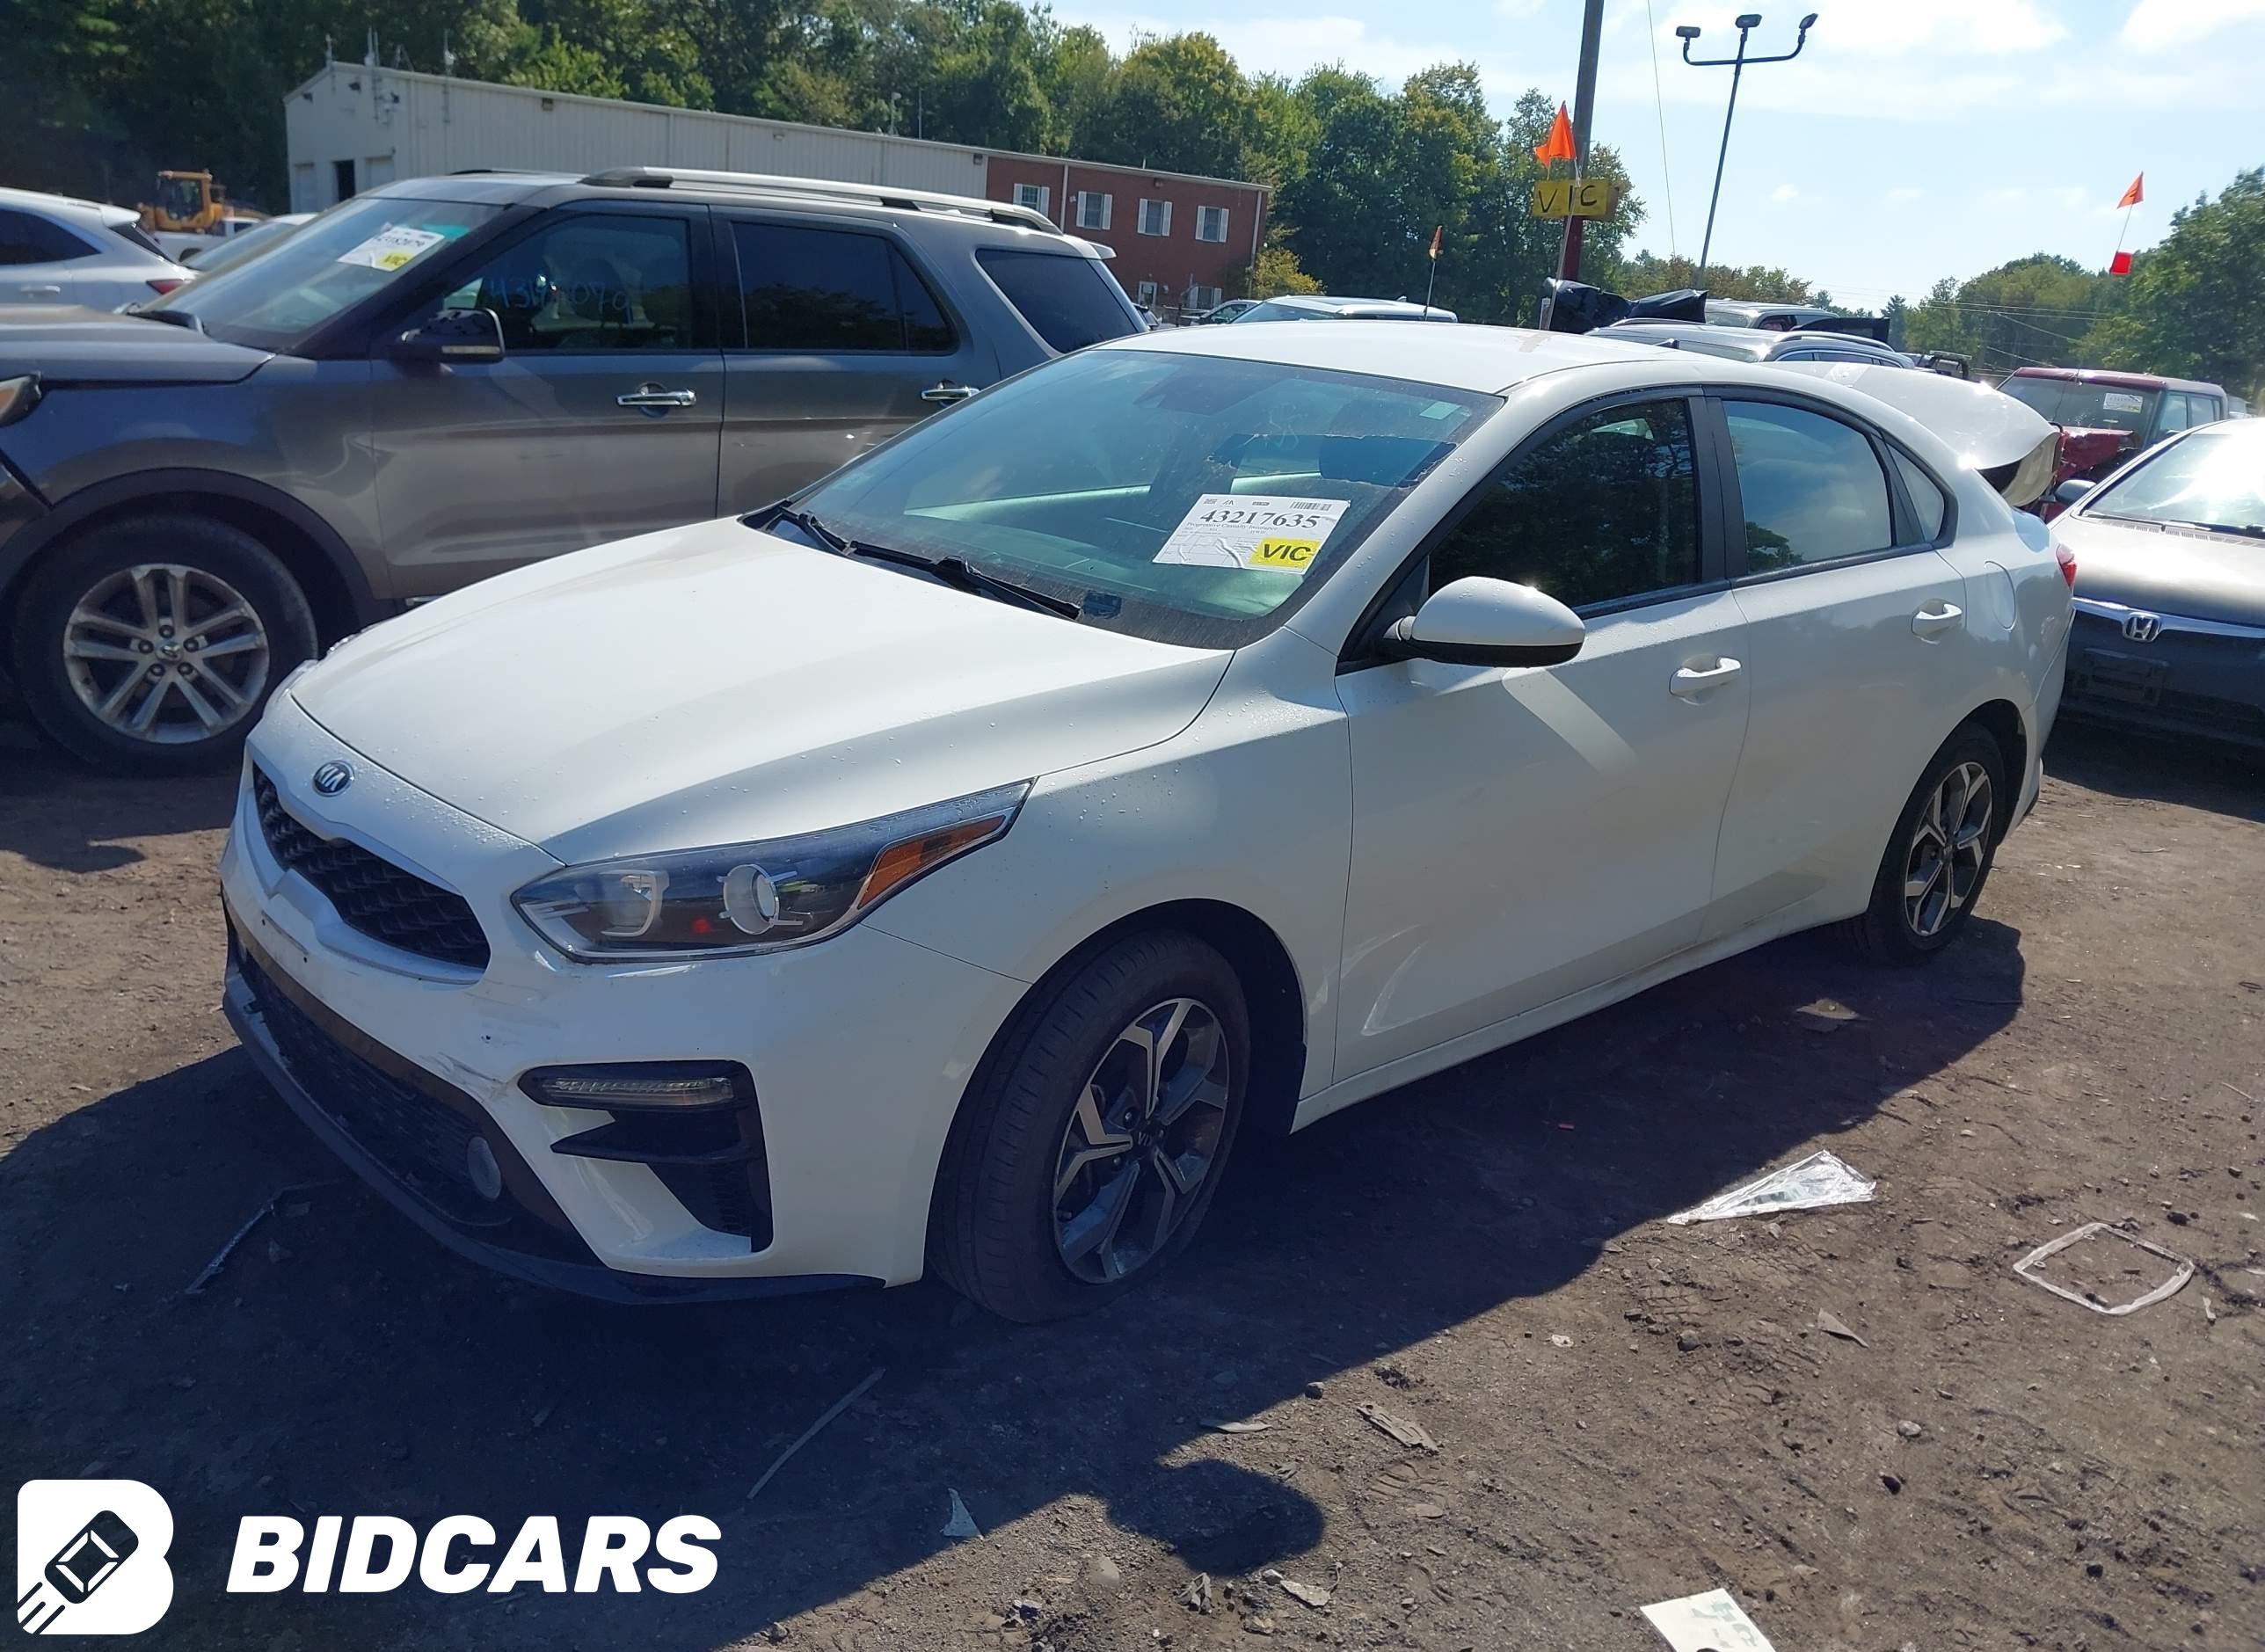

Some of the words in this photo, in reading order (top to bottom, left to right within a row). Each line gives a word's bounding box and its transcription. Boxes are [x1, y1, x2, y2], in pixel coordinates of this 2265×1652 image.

[1538, 185, 1598, 213] VIC
[1199, 508, 1321, 528] 43217635
[1263, 543, 1312, 561] VIC
